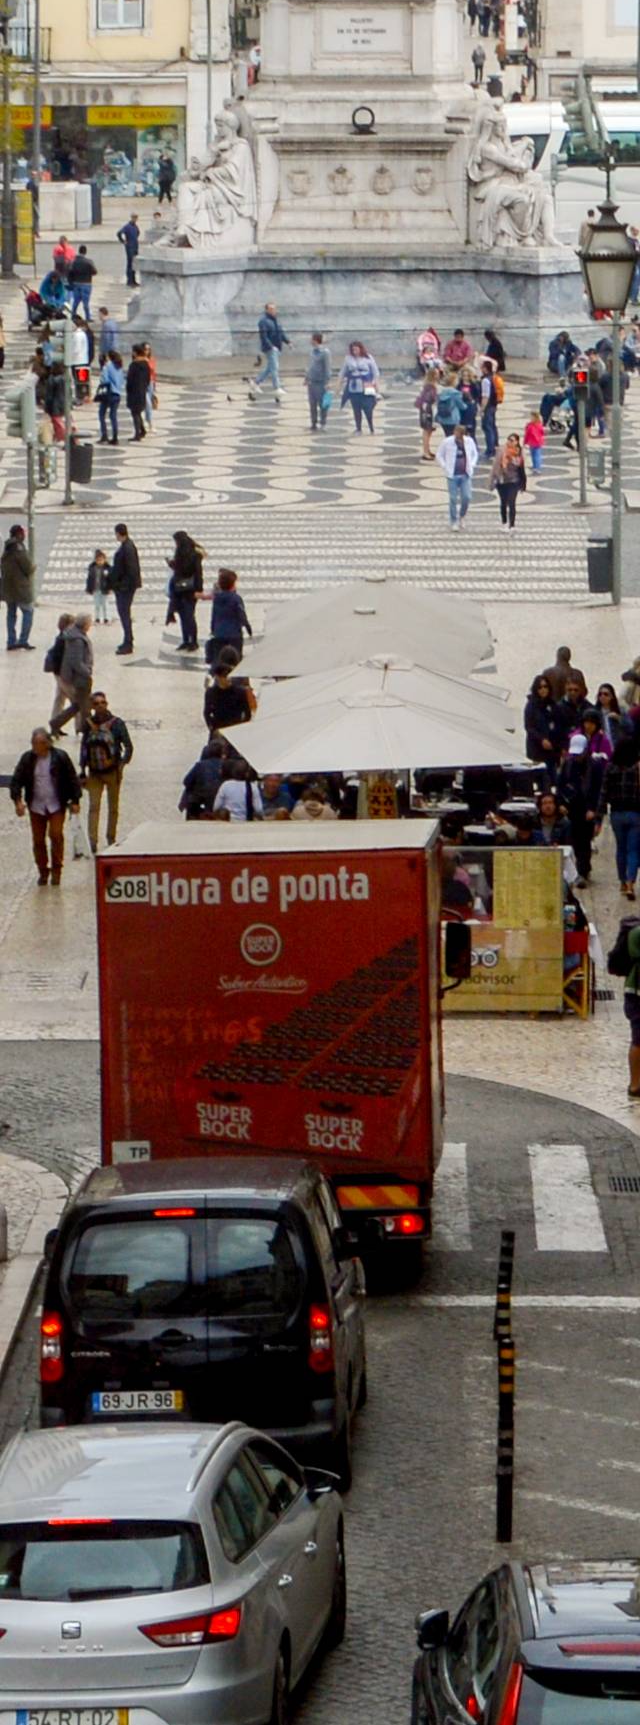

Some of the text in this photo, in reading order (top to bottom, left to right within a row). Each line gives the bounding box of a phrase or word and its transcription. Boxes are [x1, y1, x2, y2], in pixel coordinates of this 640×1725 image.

[107, 879, 148, 899] G08
[150, 865, 370, 913] Hora de ponta
[196, 1102, 253, 1124] SUPER
[200, 1119, 251, 1140] BOCK
[304, 1113, 364, 1136] SUPER
[129, 1146, 149, 1160] TP
[308, 1132, 363, 1153] BOCK
